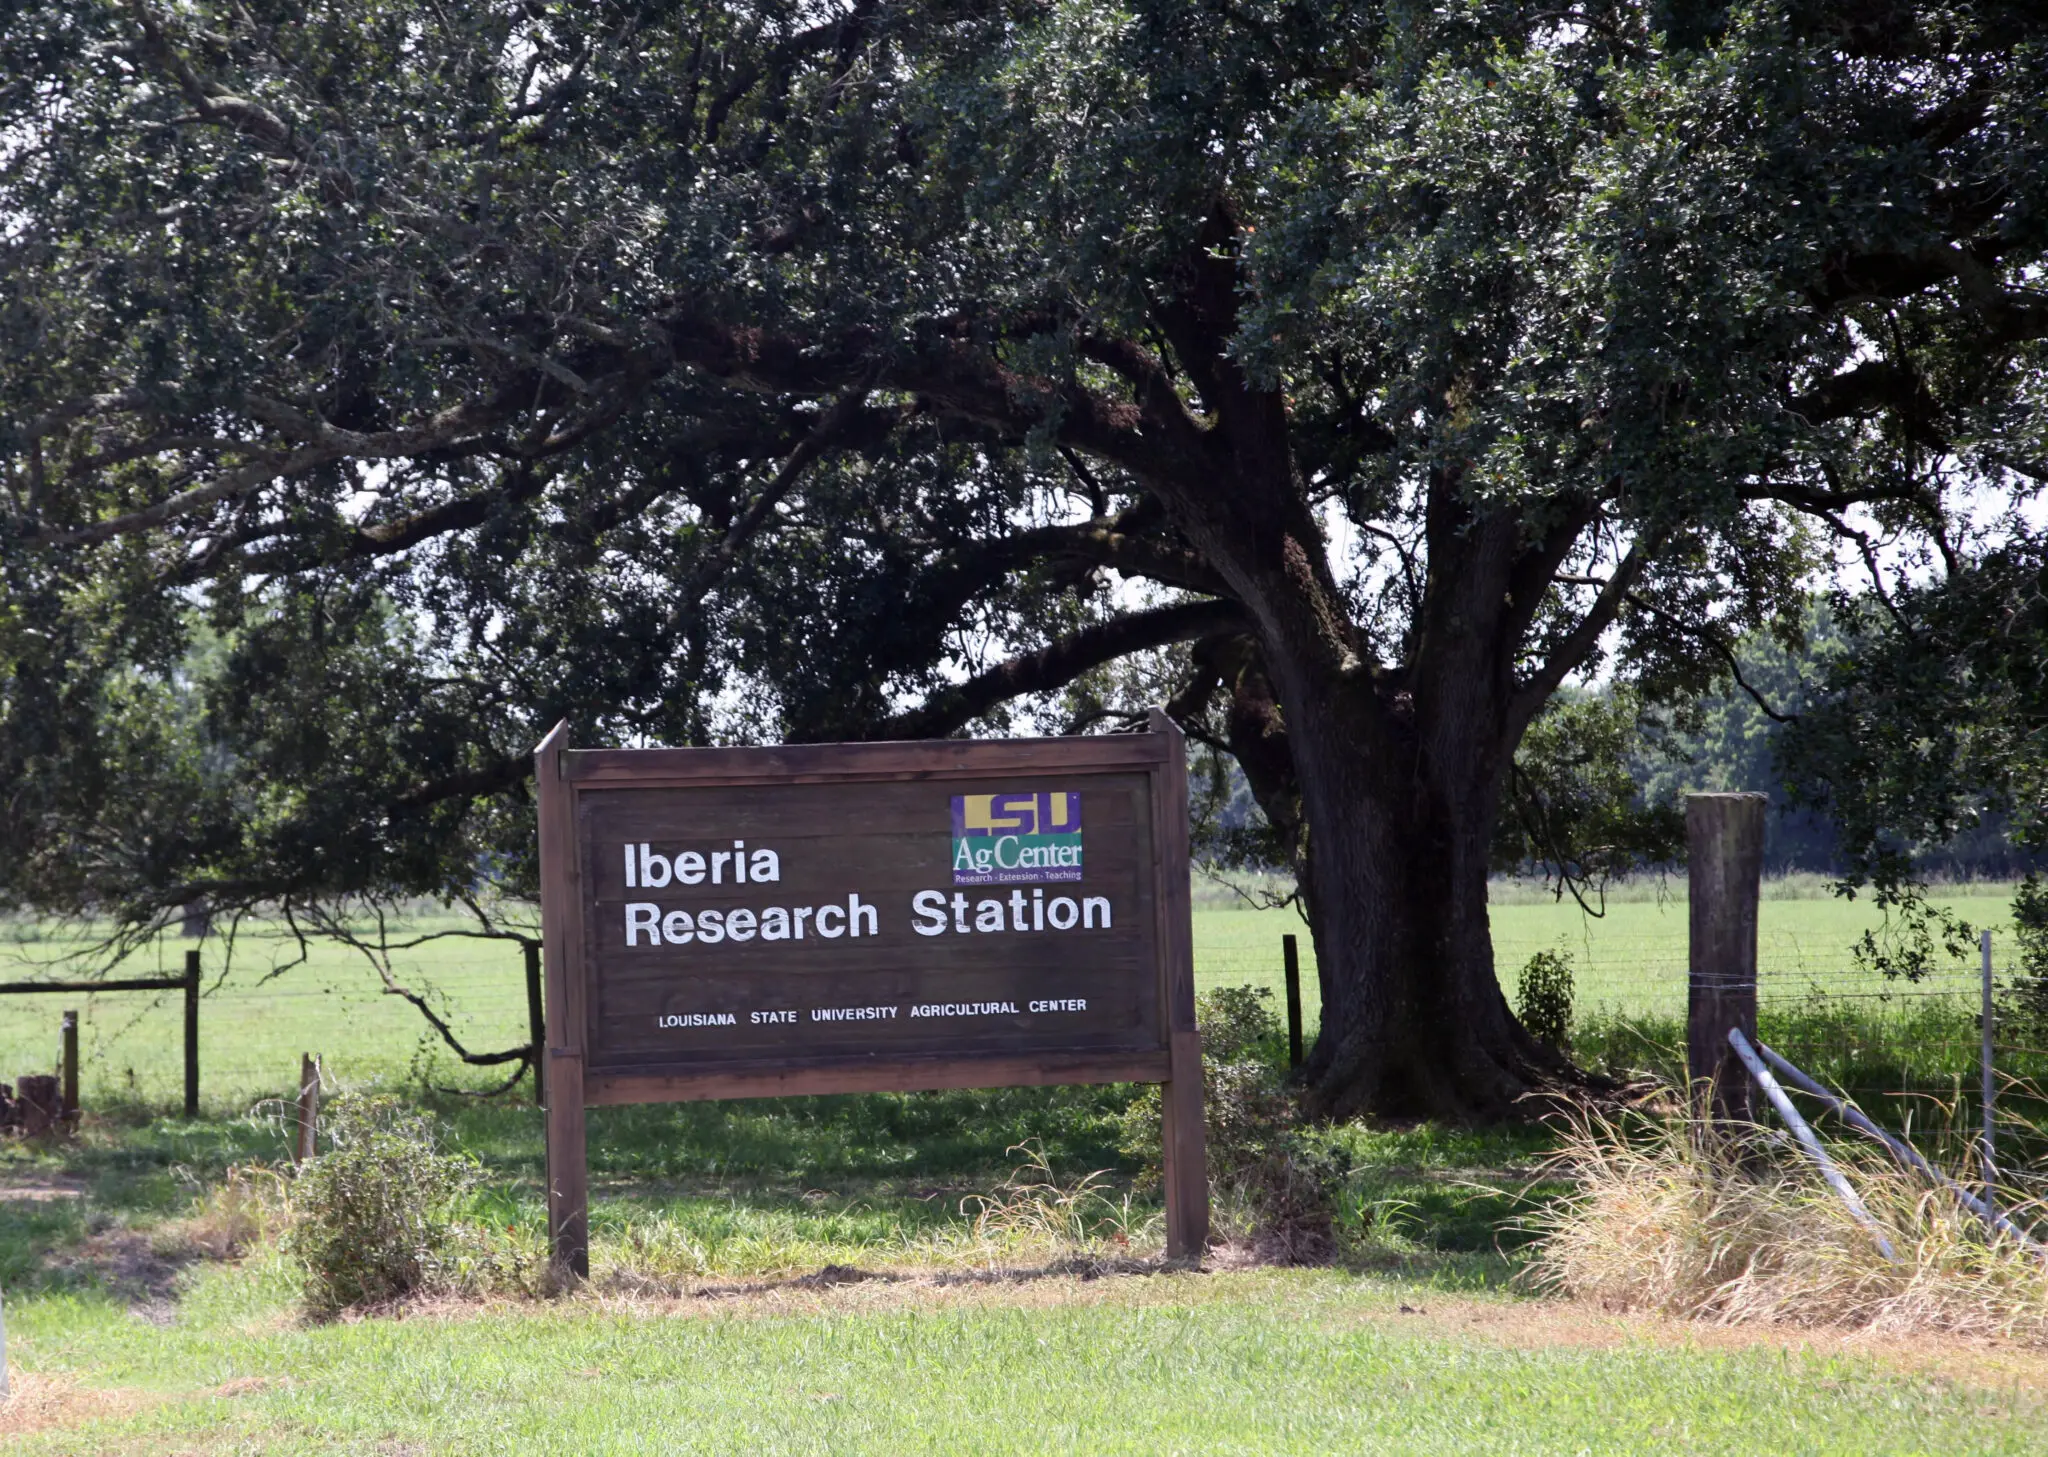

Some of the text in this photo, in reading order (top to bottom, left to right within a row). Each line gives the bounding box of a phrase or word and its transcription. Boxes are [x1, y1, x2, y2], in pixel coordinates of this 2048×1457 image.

[951, 792, 1082, 837] LSU
[624, 840, 780, 888] Iberia
[955, 870, 1082, 883] Research Extension Teaching
[625, 888, 1111, 947] Research Station
[659, 998, 1087, 1028] LOUISIANA STATE UNIVERSITY AGRICULTURAL CENTER
